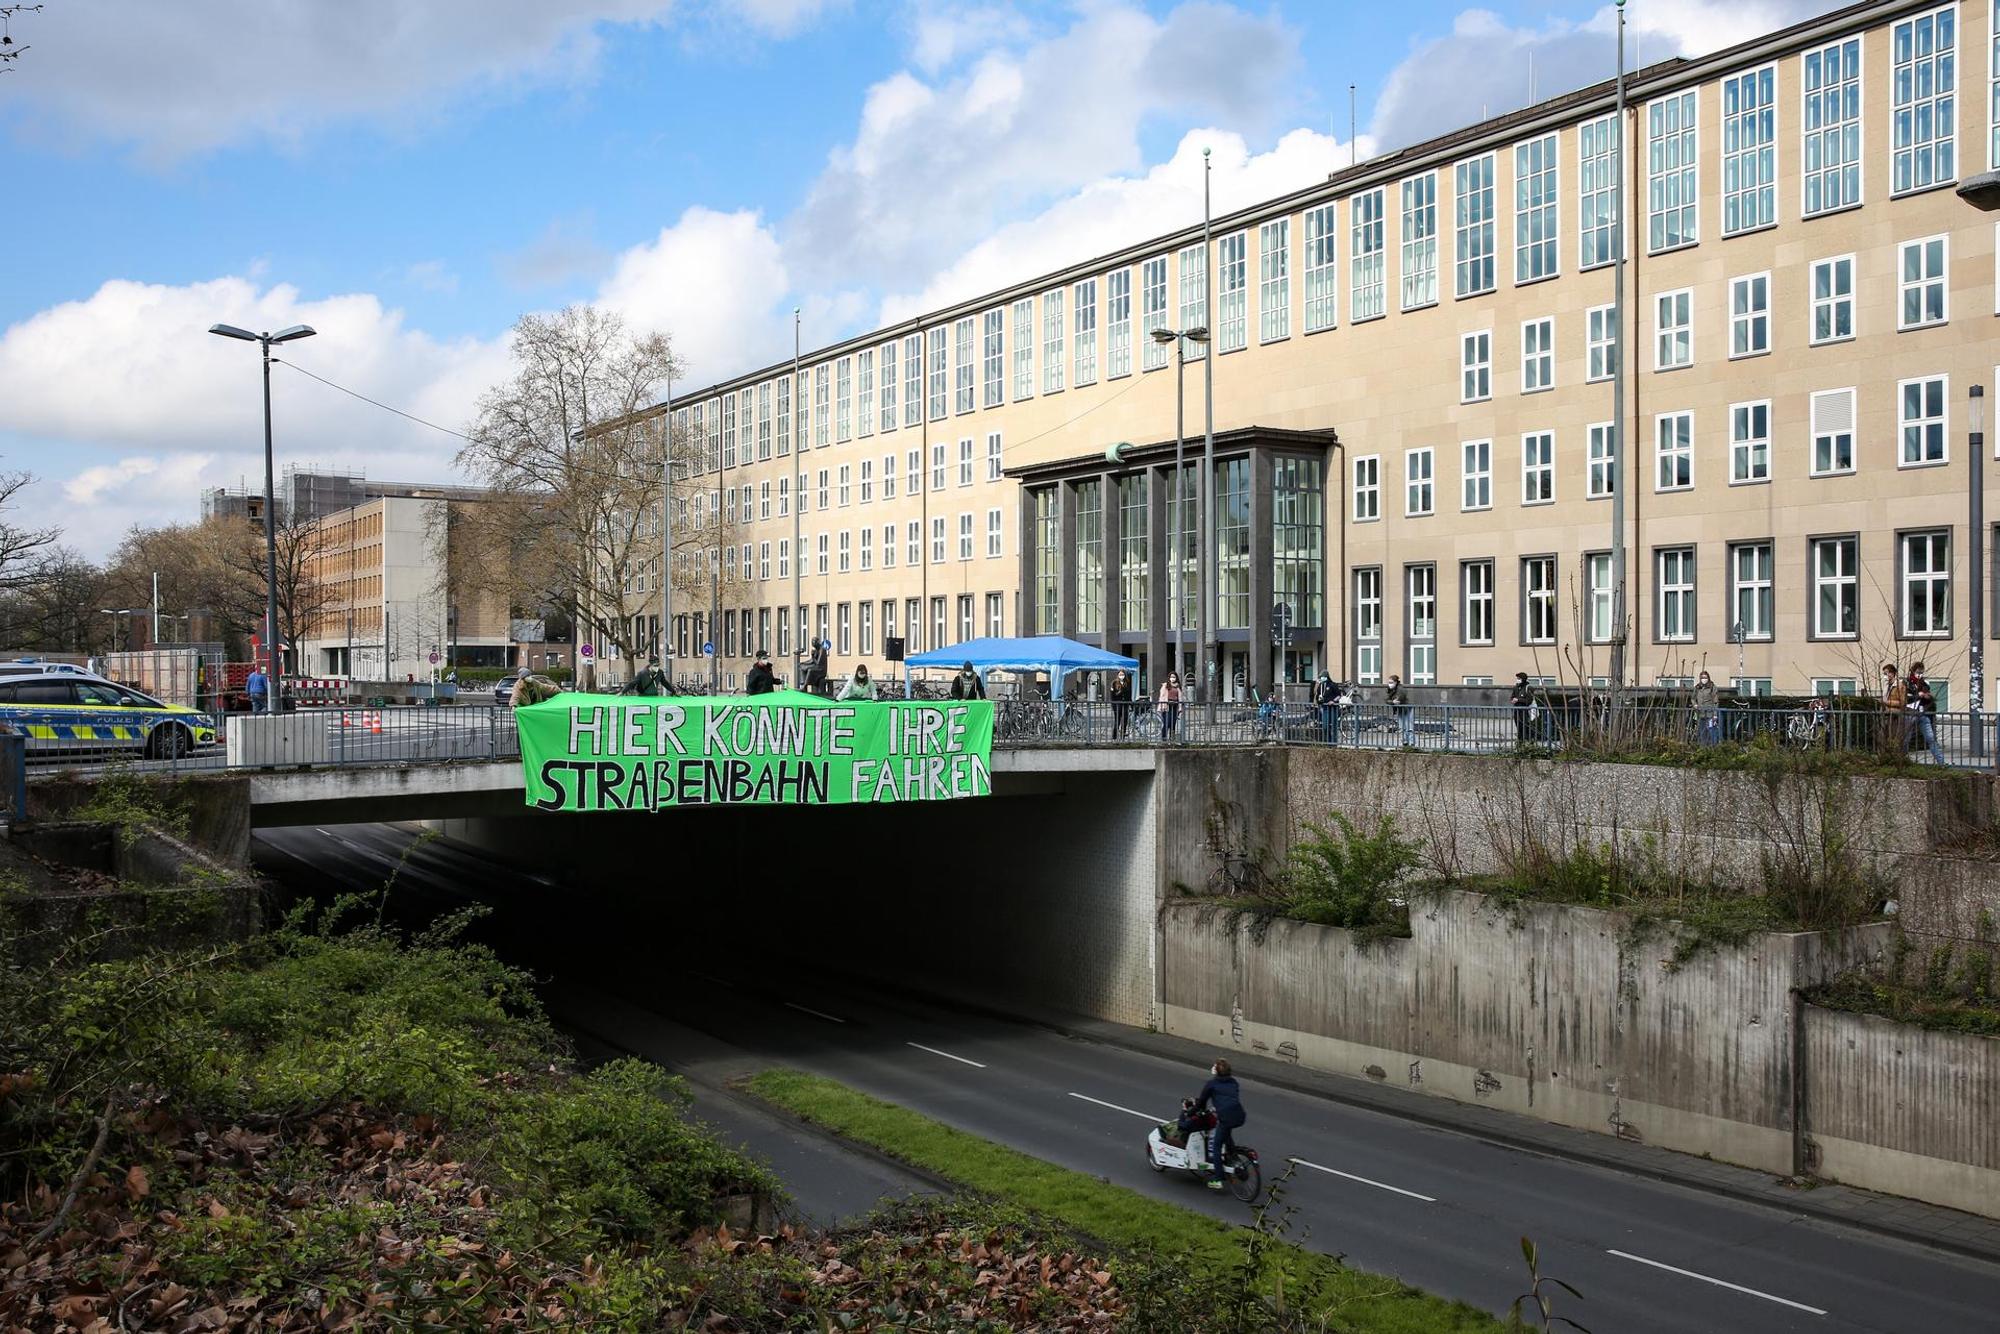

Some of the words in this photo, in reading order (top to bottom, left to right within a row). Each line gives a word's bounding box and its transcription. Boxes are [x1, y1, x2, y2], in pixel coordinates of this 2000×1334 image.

[97, 716, 134, 724] POLIZEI
[568, 705, 688, 756] HIER
[703, 704, 855, 757] KÖNNTE
[889, 706, 968, 755] IHRE
[851, 752, 992, 802] FAHREN
